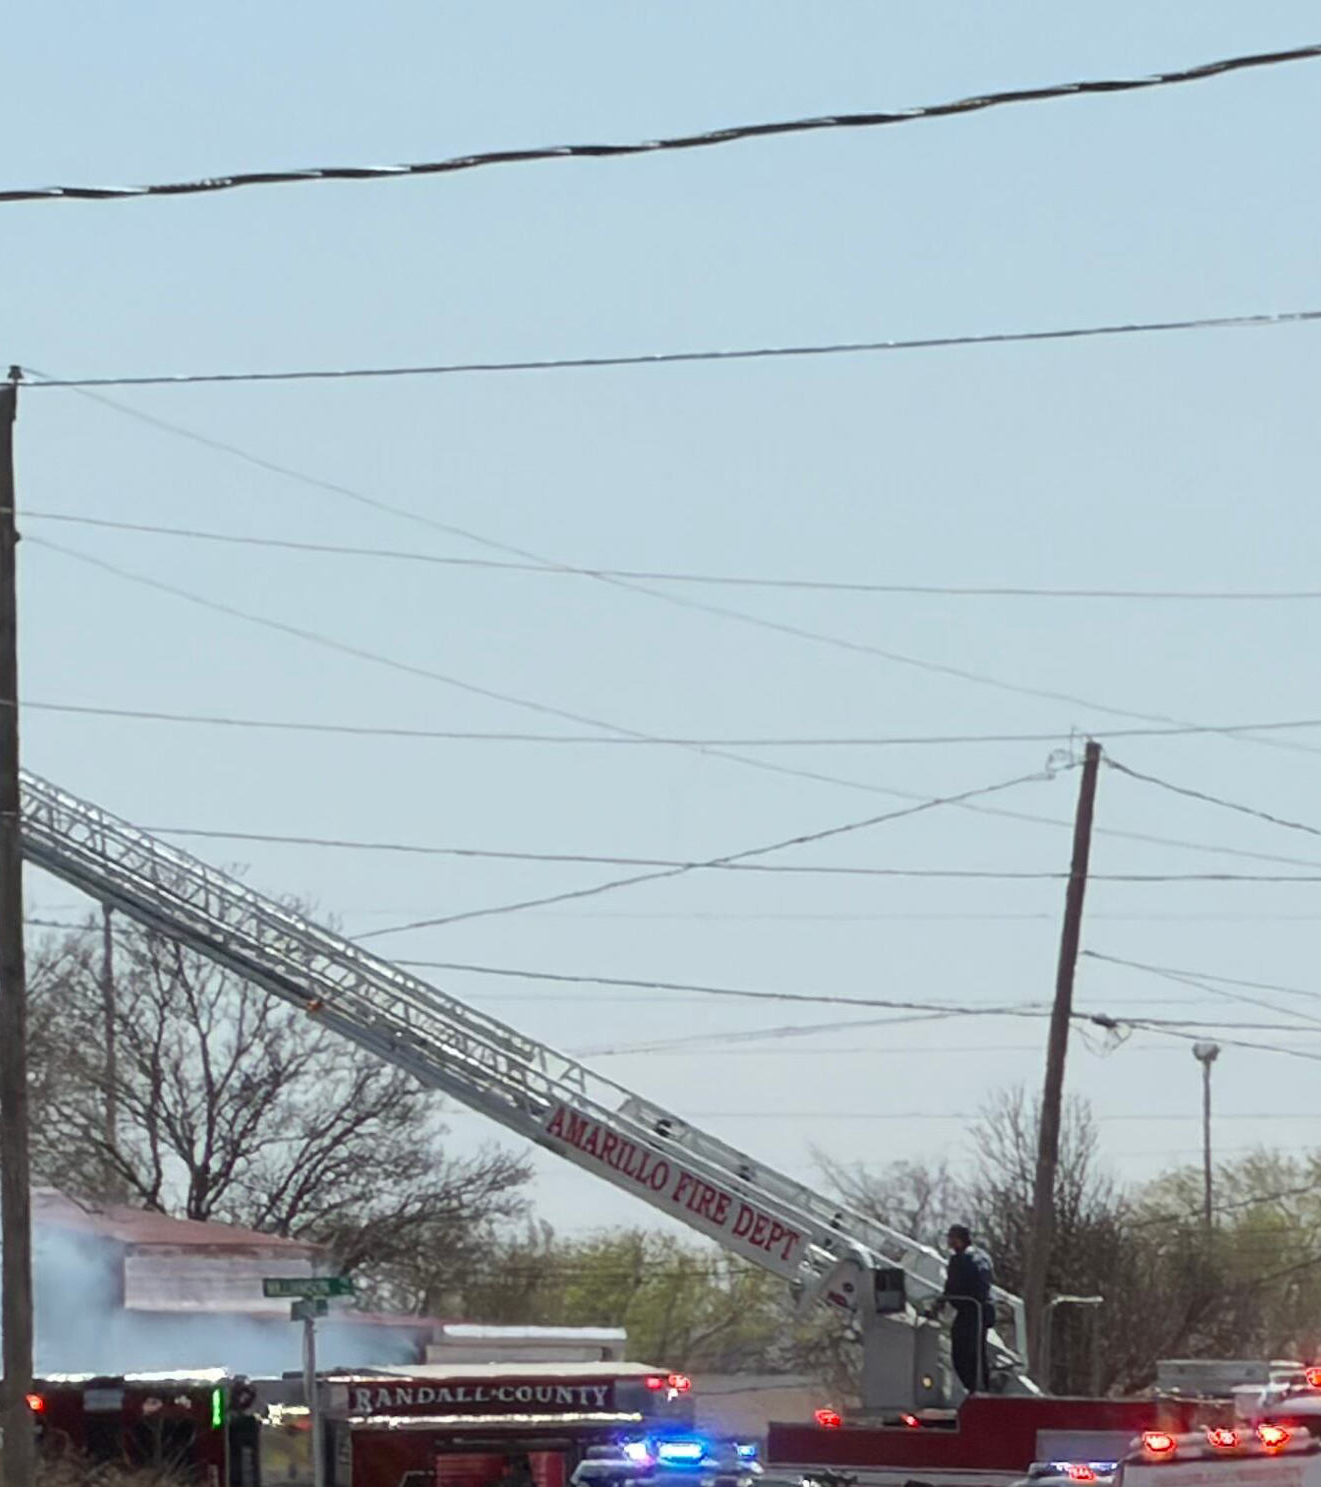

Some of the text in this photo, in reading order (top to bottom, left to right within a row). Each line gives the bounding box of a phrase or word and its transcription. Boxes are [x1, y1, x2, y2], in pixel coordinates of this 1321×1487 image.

[546, 1107, 800, 1261] AMARILLO FIRE DEPT
[355, 1385, 608, 1413] RANDALL COUNTY
